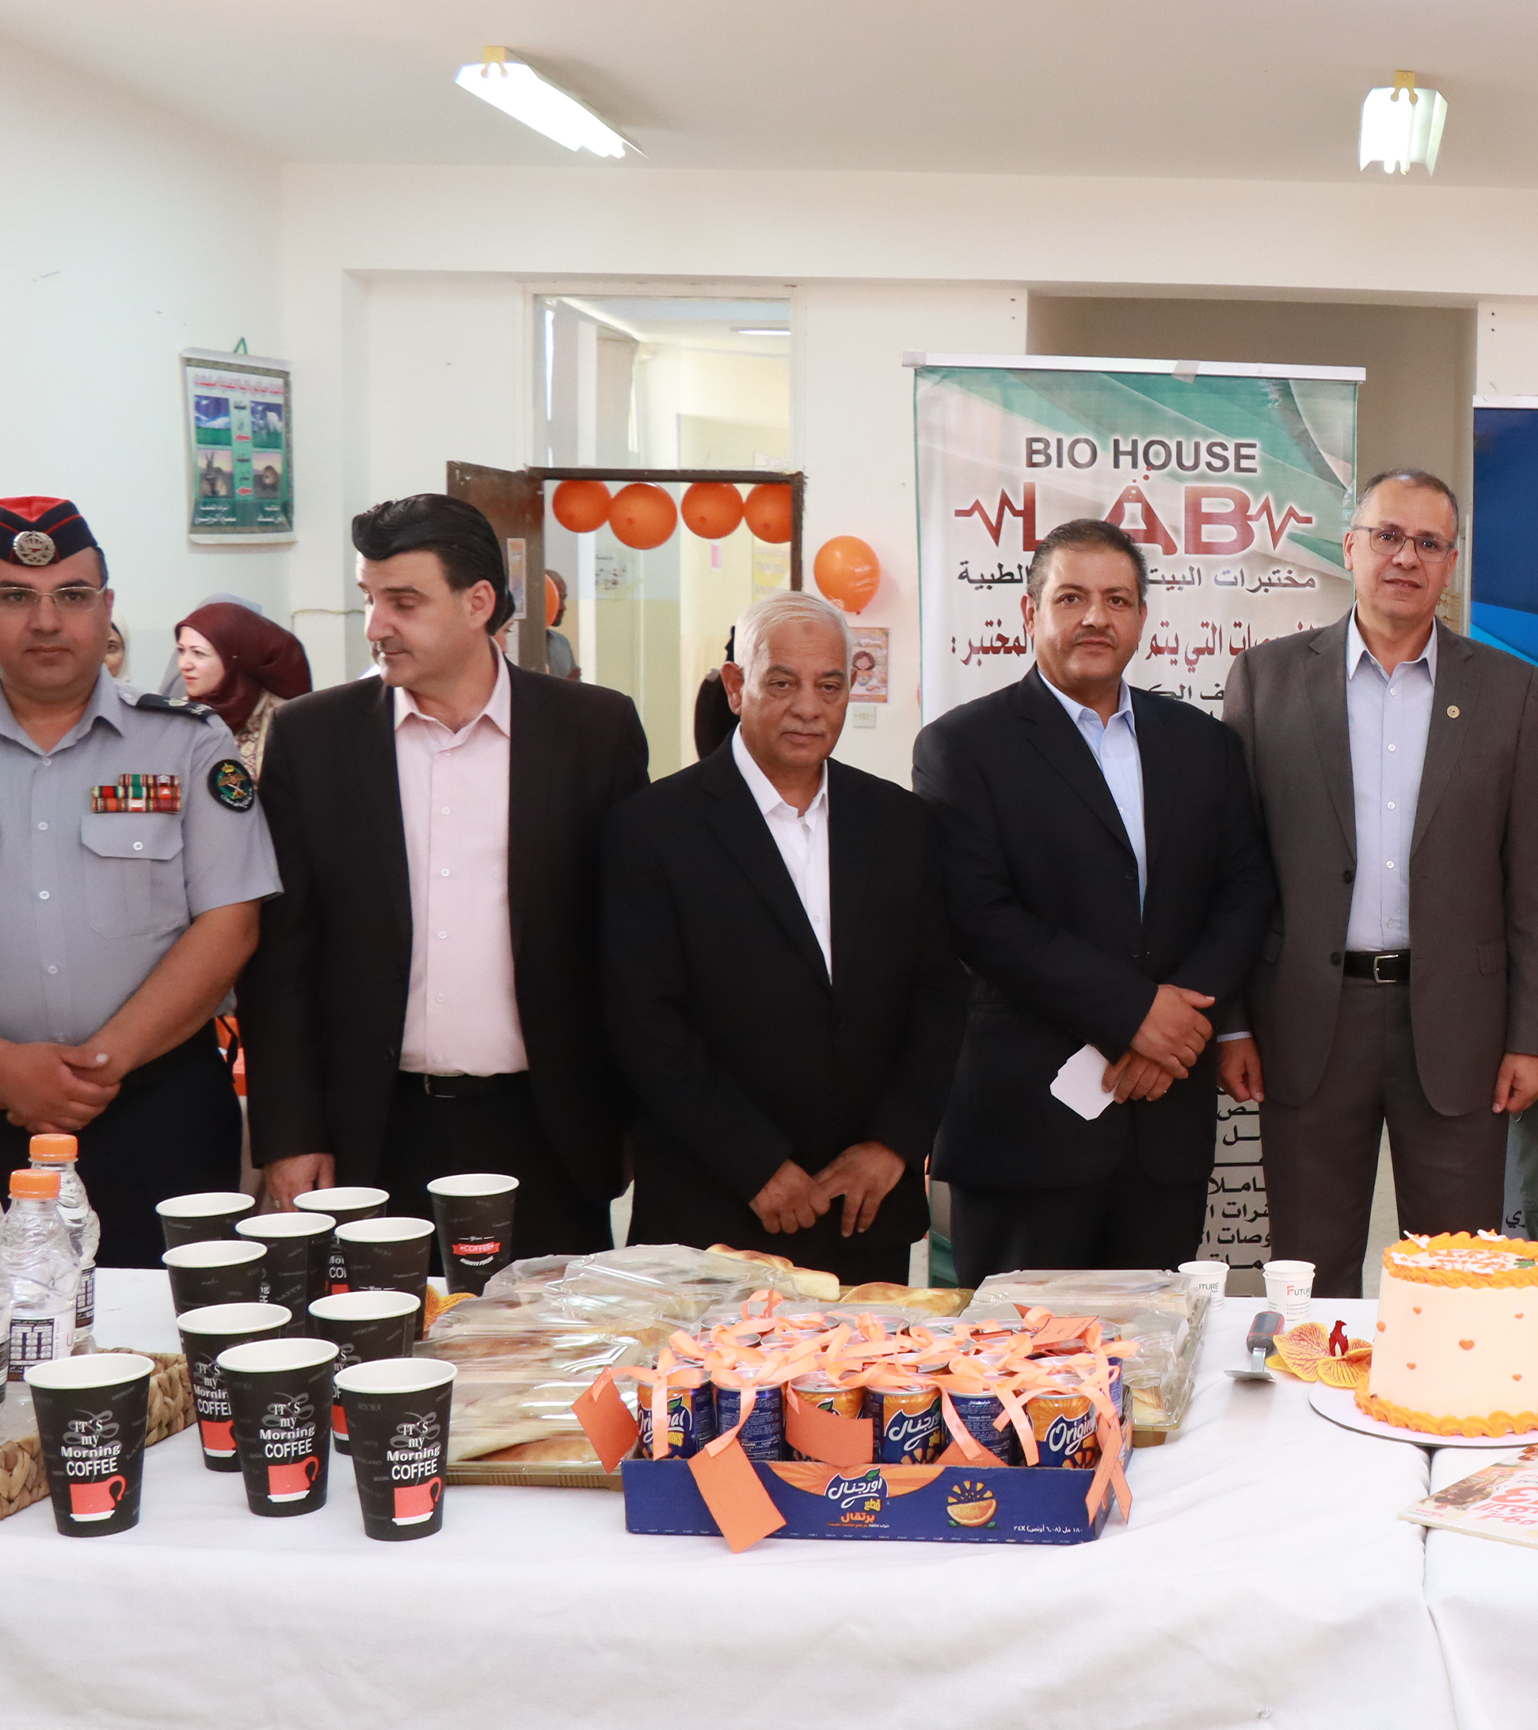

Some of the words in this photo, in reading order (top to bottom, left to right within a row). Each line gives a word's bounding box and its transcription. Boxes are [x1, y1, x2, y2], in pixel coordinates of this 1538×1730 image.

[1024, 437, 1097, 470] BIO
[1112, 438, 1259, 474] HOUSE
[1213, 567, 1316, 594] مختبرات
[1144, 619, 1179, 667] يتم
[1184, 620, 1223, 674] التي
[203, 1376, 219, 1389] my
[279, 1416, 298, 1430] my
[81, 1434, 99, 1448] my
[259, 1425, 316, 1441] Morning
[264, 1438, 313, 1459] COFFEE
[408, 1435, 426, 1450] my
[61, 1444, 121, 1459] Morning
[386, 1445, 442, 1462] Morning
[66, 1456, 118, 1477] COFFEE
[391, 1457, 438, 1480] COFFEE
[828, 1477, 883, 1503] اورجنال
[863, 1498, 882, 1512] قطع
[840, 1511, 876, 1523] برتقال
